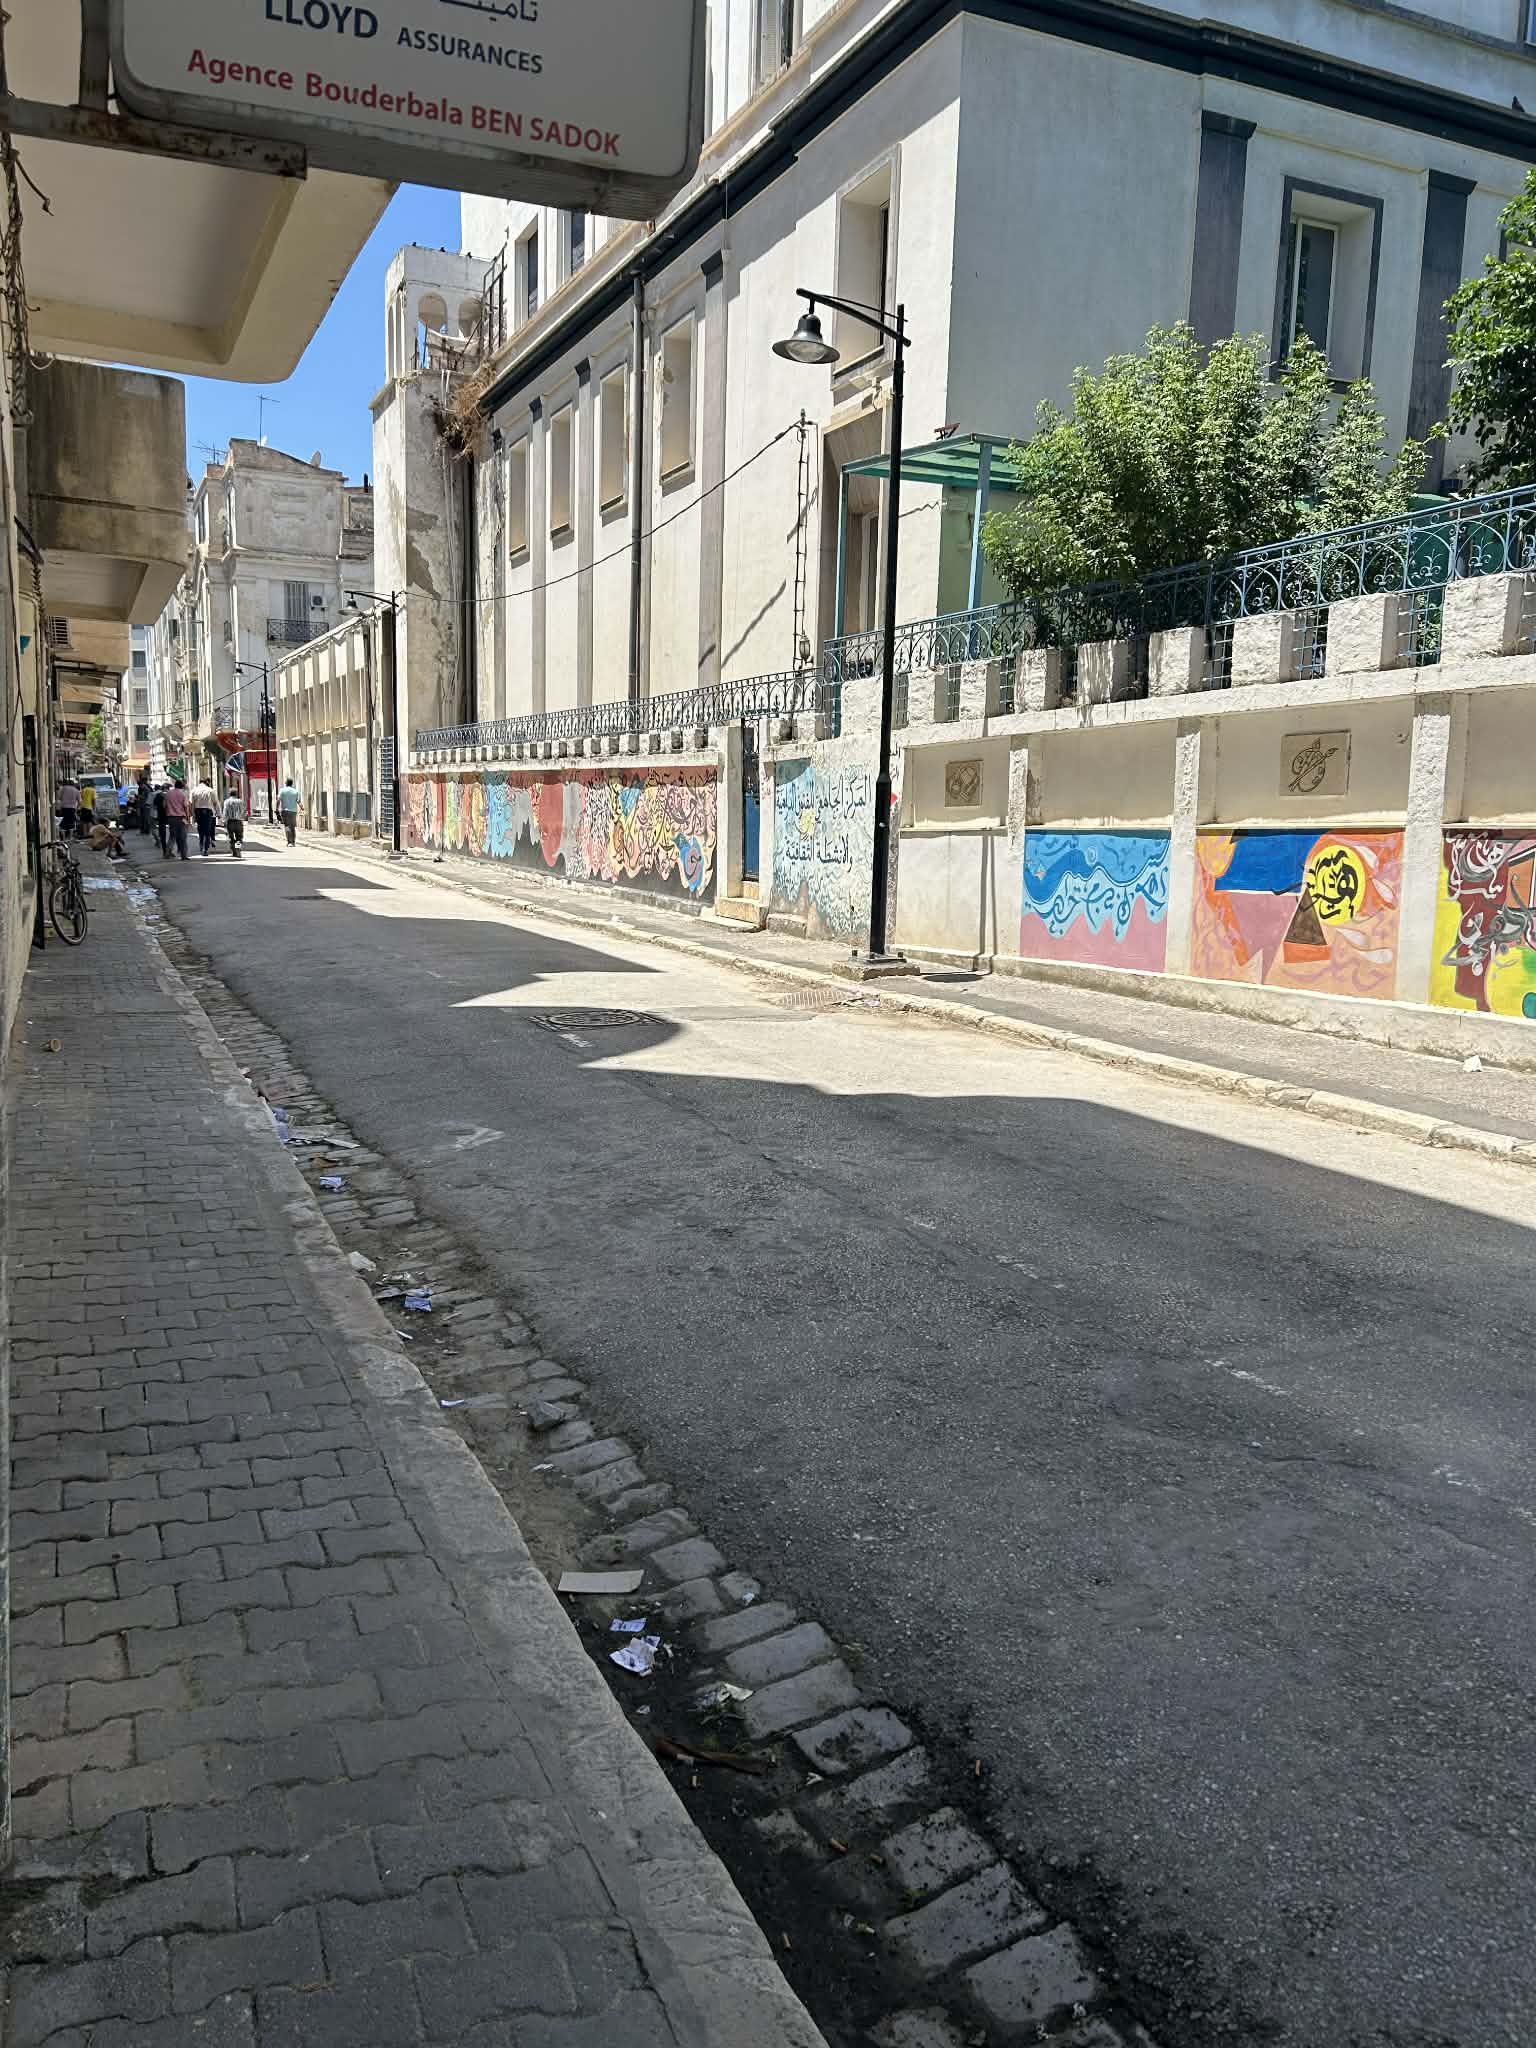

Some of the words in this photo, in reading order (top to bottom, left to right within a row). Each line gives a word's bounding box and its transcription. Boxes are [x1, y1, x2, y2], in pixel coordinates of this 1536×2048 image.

[265, 0, 378, 39] LLOYD
[397, 27, 543, 74] ASSURANCES
[187, 49, 294, 90] Agence
[306, 72, 463, 125] Bouderbala
[471, 105, 522, 137] BEN
[529, 117, 621, 156] SADOK
